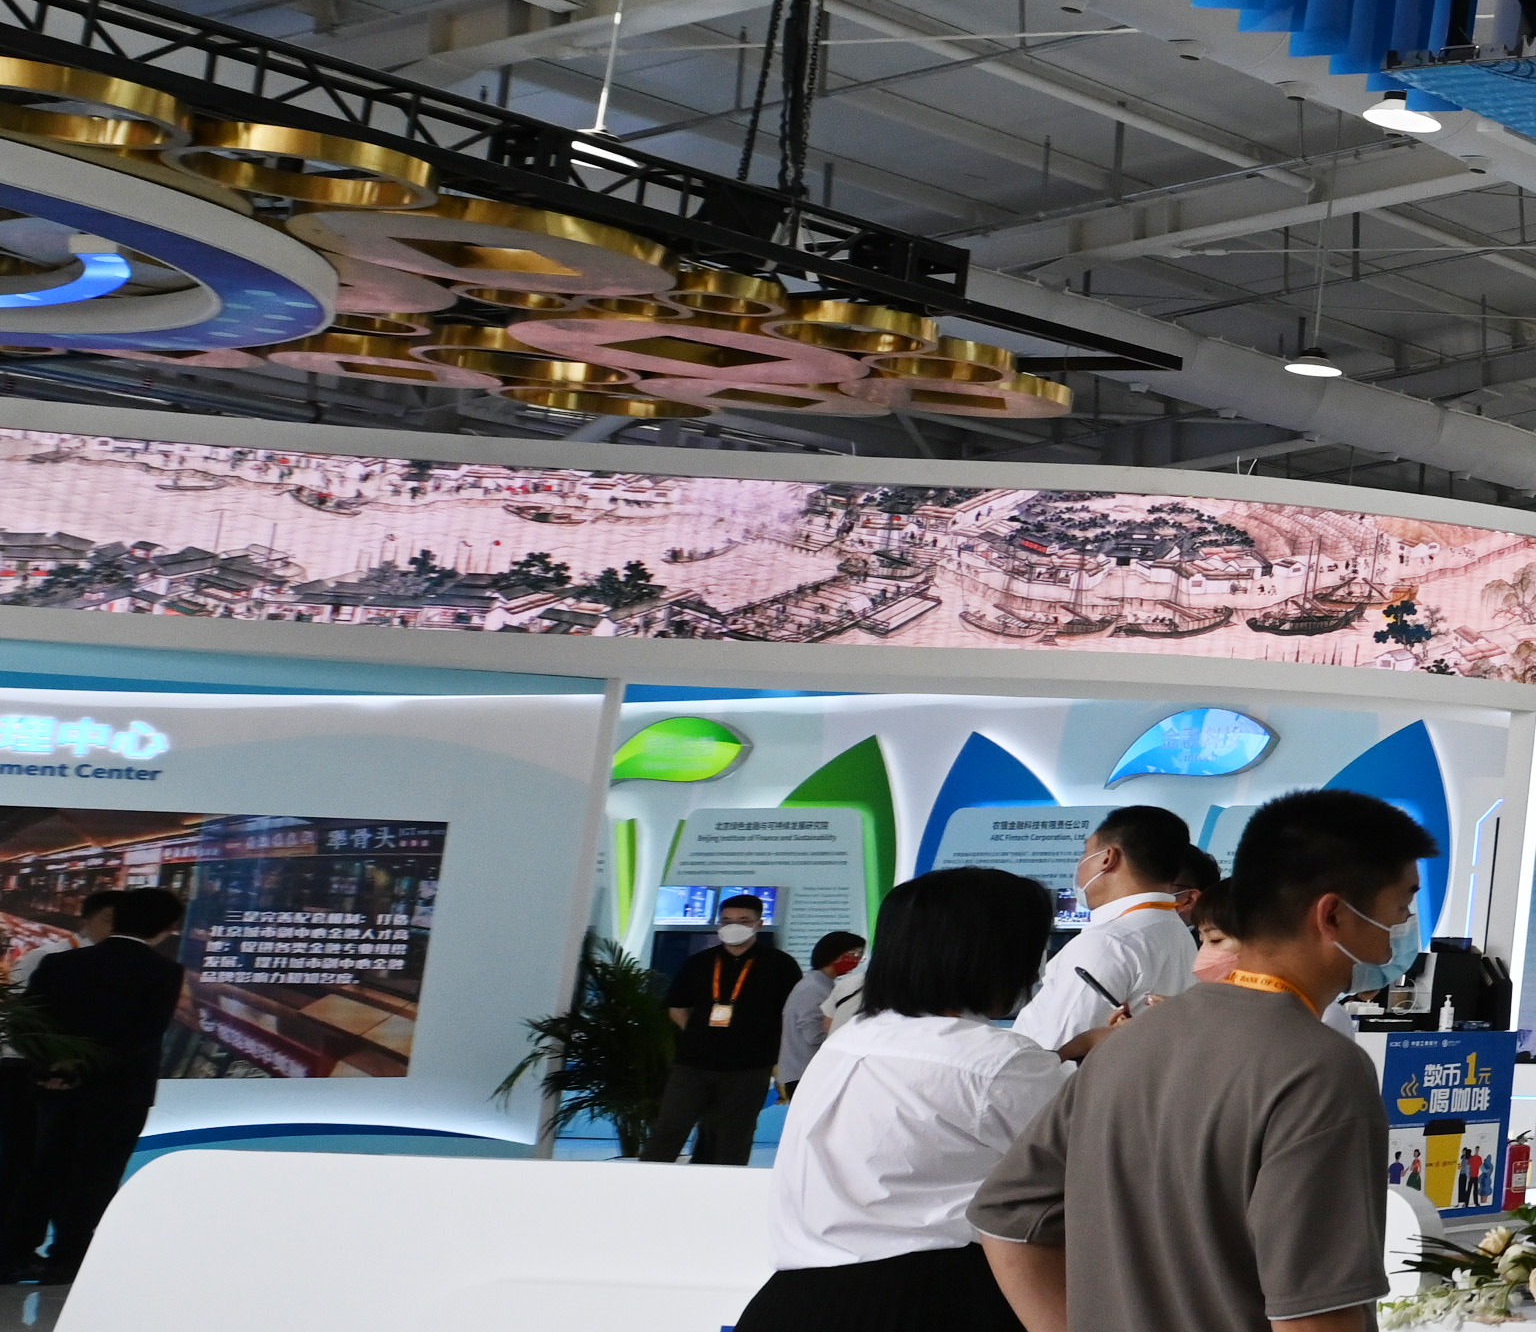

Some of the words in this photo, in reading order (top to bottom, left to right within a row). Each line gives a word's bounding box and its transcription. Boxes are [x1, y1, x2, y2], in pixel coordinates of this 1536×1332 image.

[74, 763, 163, 780] Center
[1429, 1087, 1491, 1114] 喝咖啡
